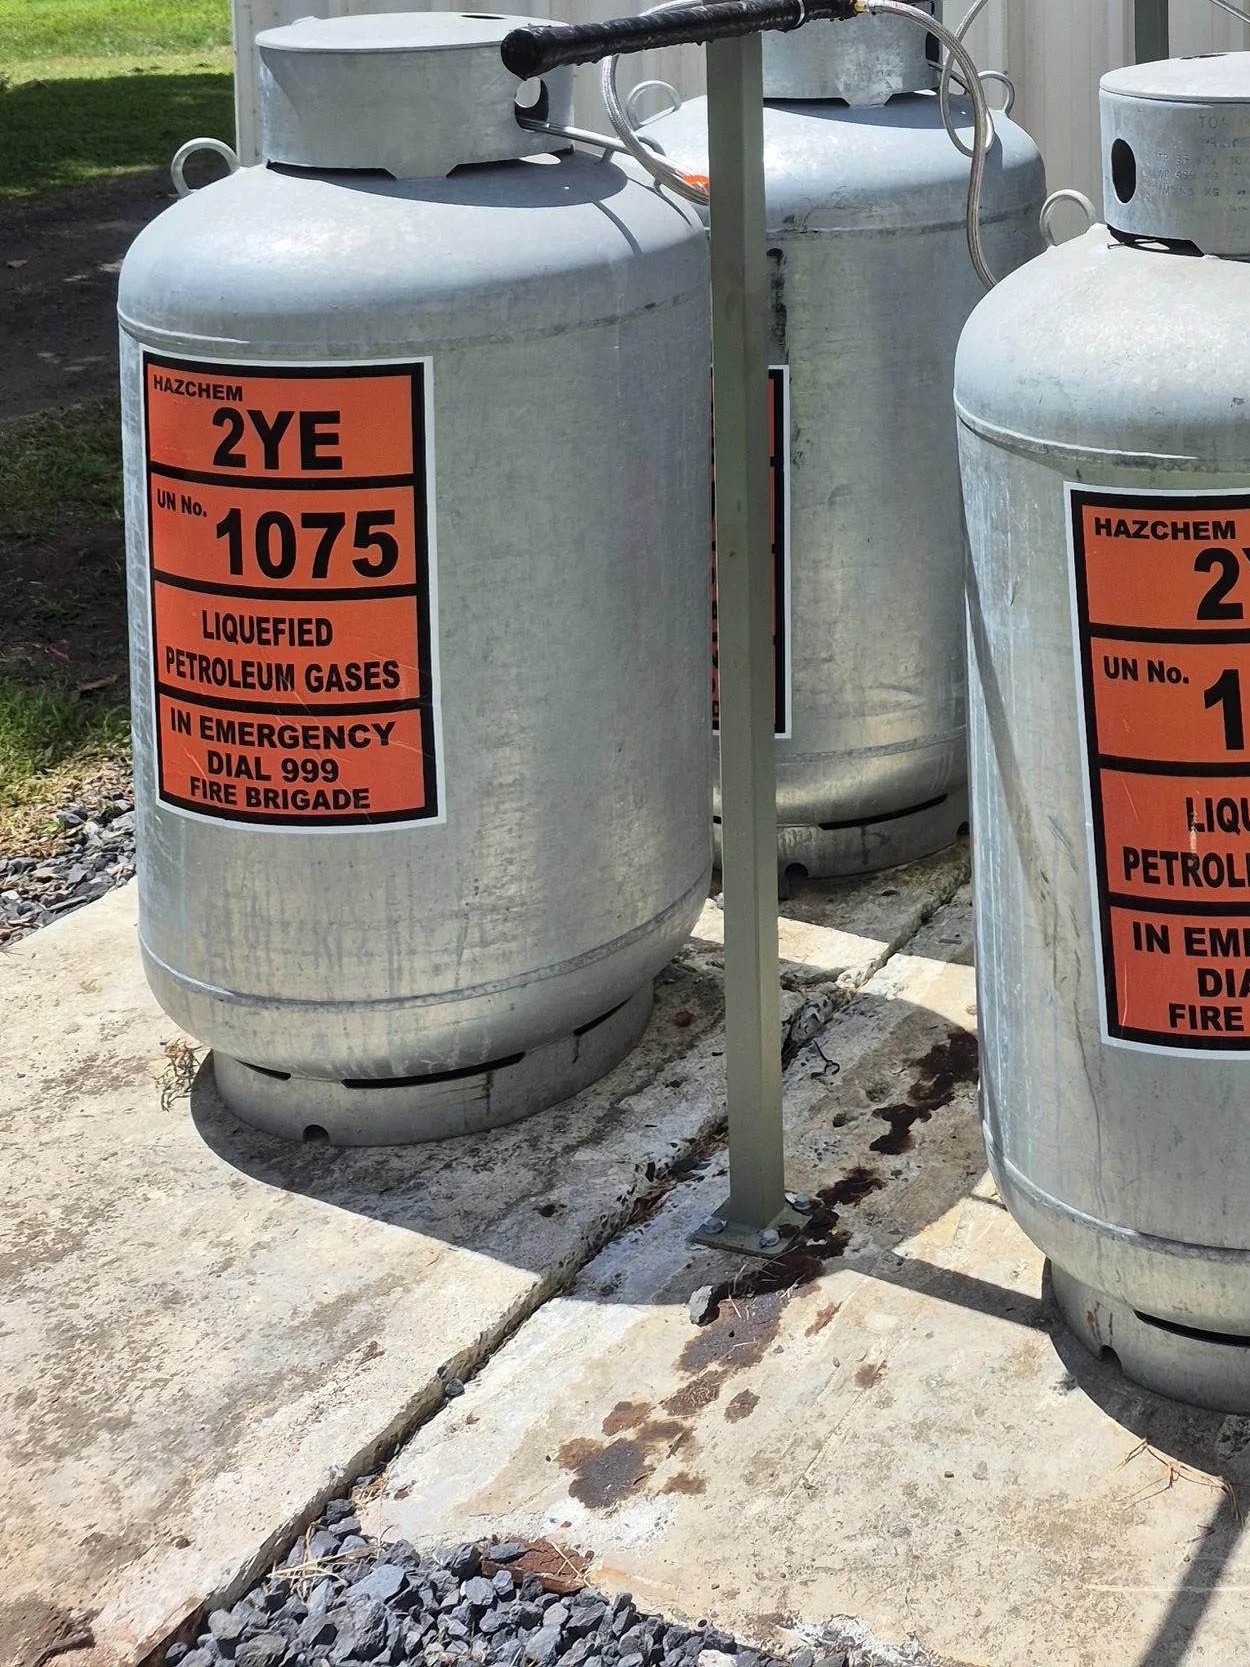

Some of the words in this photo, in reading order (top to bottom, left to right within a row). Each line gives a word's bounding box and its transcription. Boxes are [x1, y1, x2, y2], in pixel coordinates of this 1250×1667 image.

[153, 374, 243, 402] HAZCHEM
[212, 408, 343, 470] 2YE
[157, 489, 177, 511] UN
[181, 494, 207, 517] No.
[215, 508, 399, 579] 1075
[1094, 517, 1236, 540] HAZCHEM
[202, 609, 333, 646] LIQUEFIED
[165, 646, 295, 692] PETROLEUM
[305, 661, 400, 692] GASES
[1103, 656, 1139, 682] UN
[1147, 661, 1189, 685] No.
[170, 708, 192, 735] IN
[200, 721, 395, 749] EMERGENCY
[207, 750, 272, 781] DIAL
[281, 758, 339, 782] 999
[190, 777, 237, 805] FIRE
[246, 787, 370, 810] BRIGADE
[1133, 921, 1170, 954] IN
[1169, 1004, 1243, 1031] FIRE
